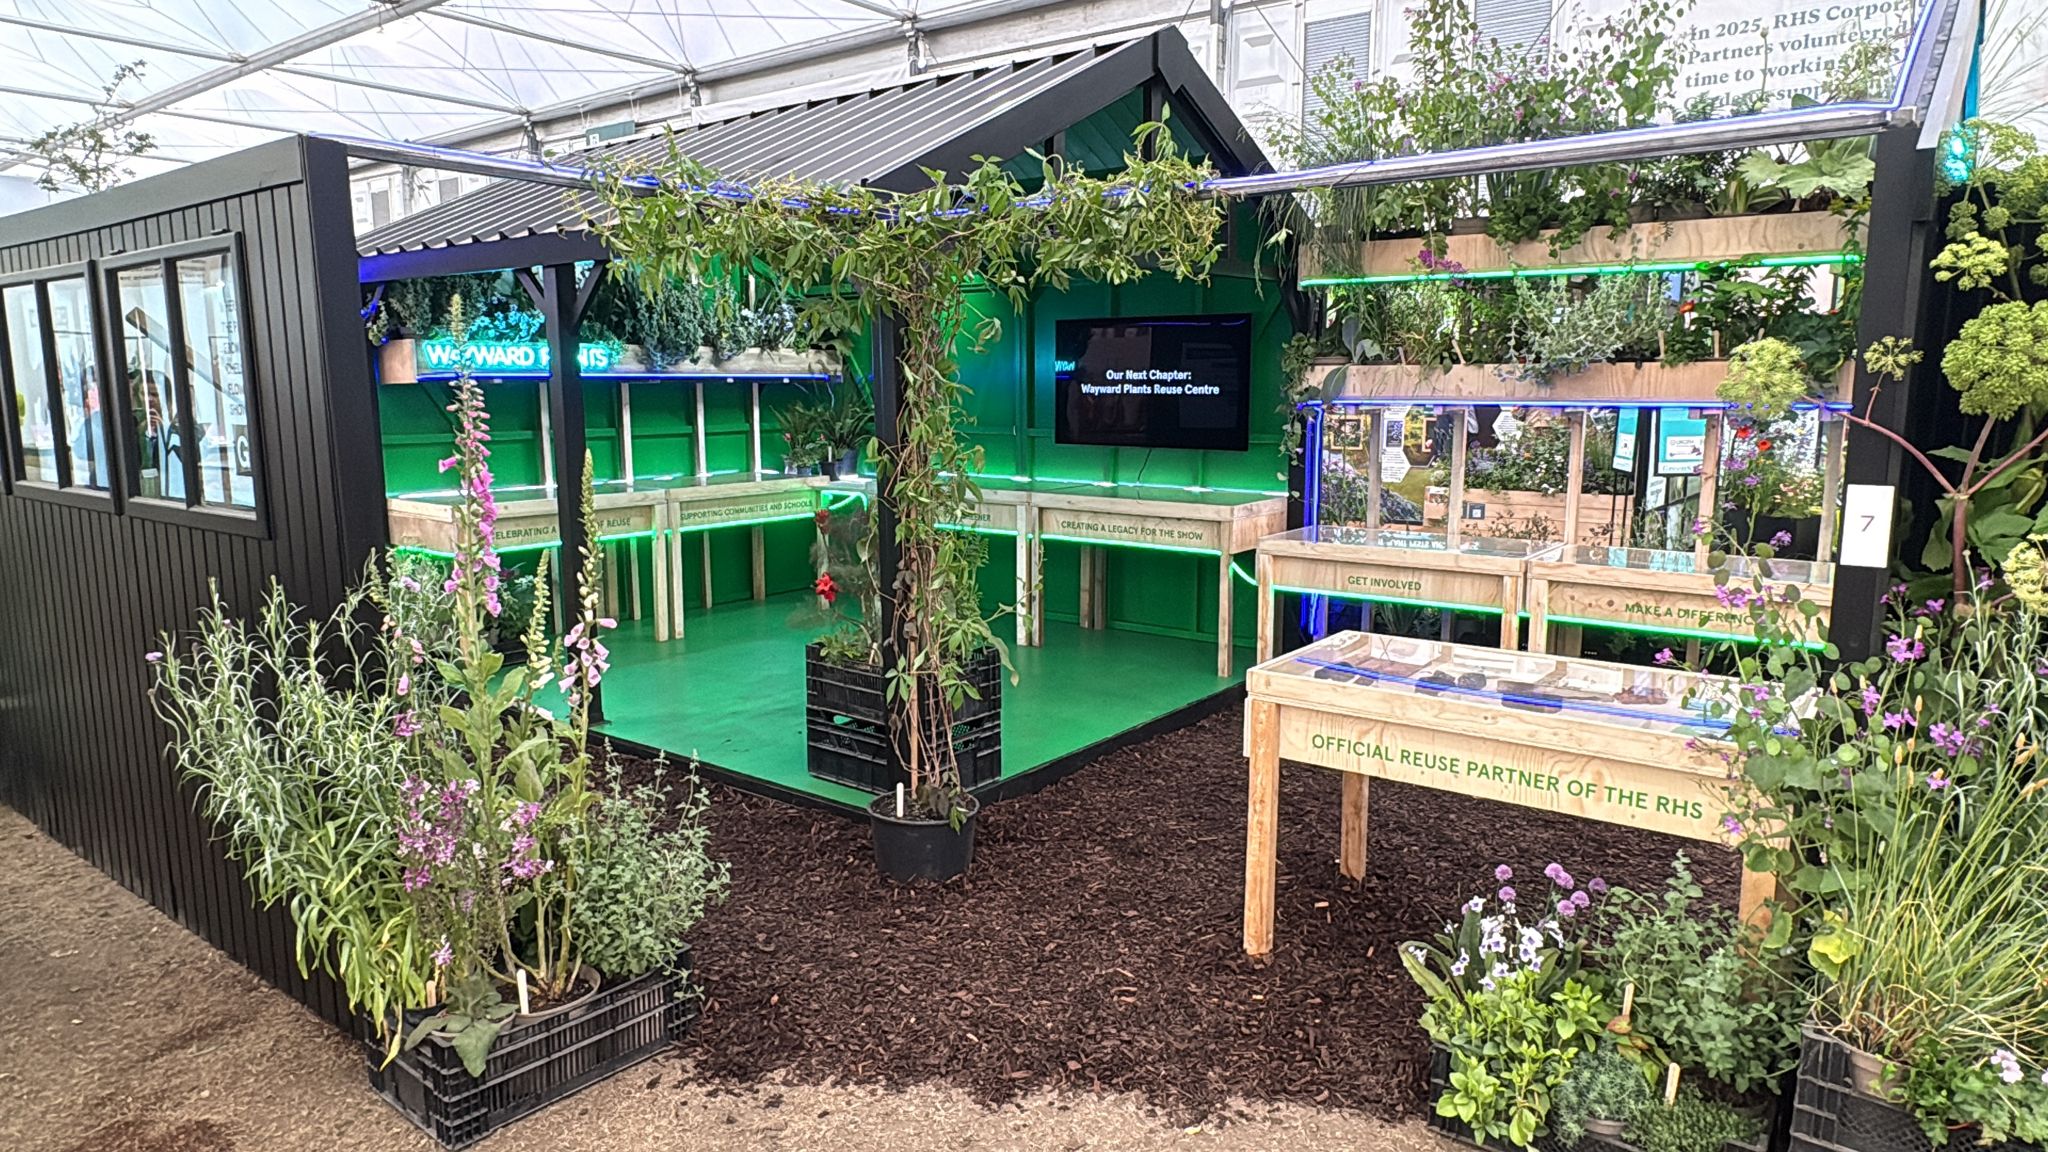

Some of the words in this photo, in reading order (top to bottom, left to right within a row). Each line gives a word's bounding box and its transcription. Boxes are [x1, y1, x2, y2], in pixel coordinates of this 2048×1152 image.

[1772, 8, 1820, 30] RHS
[1687, 43, 1773, 65] Partners
[1780, 20, 1907, 53] volunteered
[1685, 70, 1729, 88] time
[1734, 66, 1755, 83] to
[1762, 56, 1837, 79] workin
[1105, 370, 1124, 380] Our
[1126, 370, 1148, 380] Next
[1149, 370, 1192, 382] Chapter:
[1081, 383, 1122, 396] Wayward
[1123, 384, 1152, 395] Plants
[1154, 384, 1183, 395] Reuse
[1184, 384, 1220, 395] Centre
[680, 509, 722, 521] SUPPORTING
[724, 504, 768, 516] COMMUNITIES
[769, 502, 782, 511] AND
[784, 500, 813, 510] SCHOOLS
[495, 526, 549, 541] ELEBRATING
[551, 525, 557, 534] A
[607, 517, 631, 528] REUSE
[1061, 520, 1098, 532] CREATING
[1101, 524, 1107, 532] A
[1108, 525, 1138, 535] LEGACY
[1141, 527, 1157, 537] FOR
[1159, 529, 1174, 539] THE
[1177, 531, 1203, 541] SHOW
[1861, 515, 1875, 532] 7
[1347, 575, 1368, 586] GET
[1370, 578, 1422, 591] INVOLVED
[1625, 603, 1661, 617] MAKE
[1665, 607, 1673, 617] A
[1677, 608, 1755, 626] DIFFERENC
[1311, 734, 1394, 763] OFFICIAL
[1400, 749, 1460, 775] REUSE
[1466, 762, 1560, 793] PARTNER
[1567, 779, 1597, 801] OF
[1603, 786, 1647, 811] THE
[1656, 795, 1703, 820] RHS
